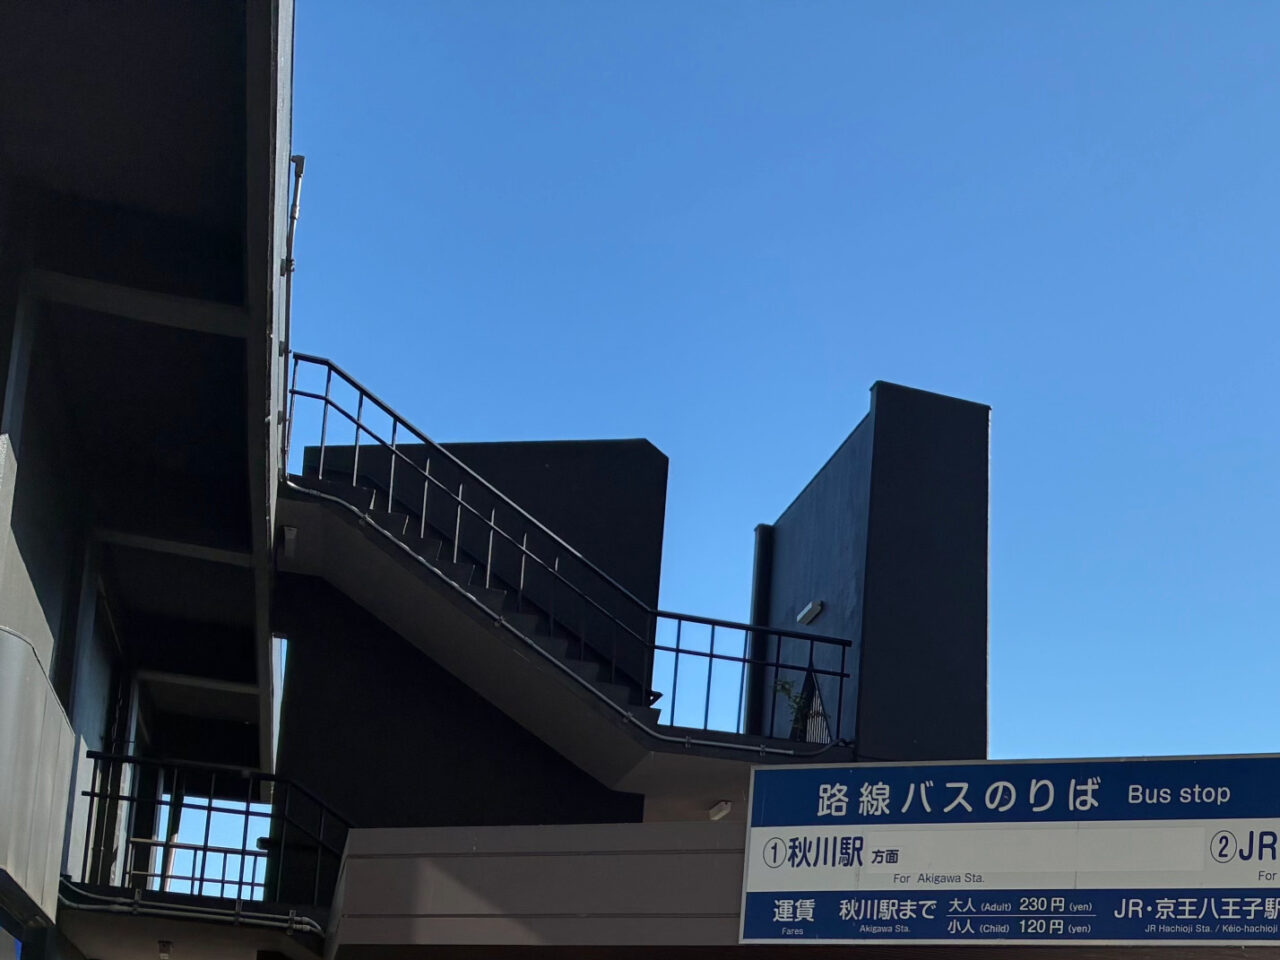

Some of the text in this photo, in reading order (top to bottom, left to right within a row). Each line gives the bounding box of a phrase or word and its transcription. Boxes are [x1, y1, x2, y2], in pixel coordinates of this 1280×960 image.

[817, 777, 1101, 817] 路線バスのりば
[1129, 784, 1230, 805] Bus stop
[872, 850, 899, 864] 方面
[894, 873, 984, 884] For Akigawa Sta.
[1258, 871, 1277, 880] For
[773, 899, 815, 921] 運賃
[839, 900, 937, 920] 秋川駅まで
[949, 898, 976, 912] 大人
[981, 903, 1011, 911] (Adult)
[1070, 903, 1092, 912] (yen)
[782, 927, 803, 935] Fares
[860, 925, 892, 933] Akigawa
[948, 919, 974, 933] 小人
[980, 925, 1009, 933] (Child)
[1068, 924, 1091, 933] (yen)
[1159, 925, 1192, 933] Hachioji
[1223, 925, 1277, 933] Keio-hachioji
